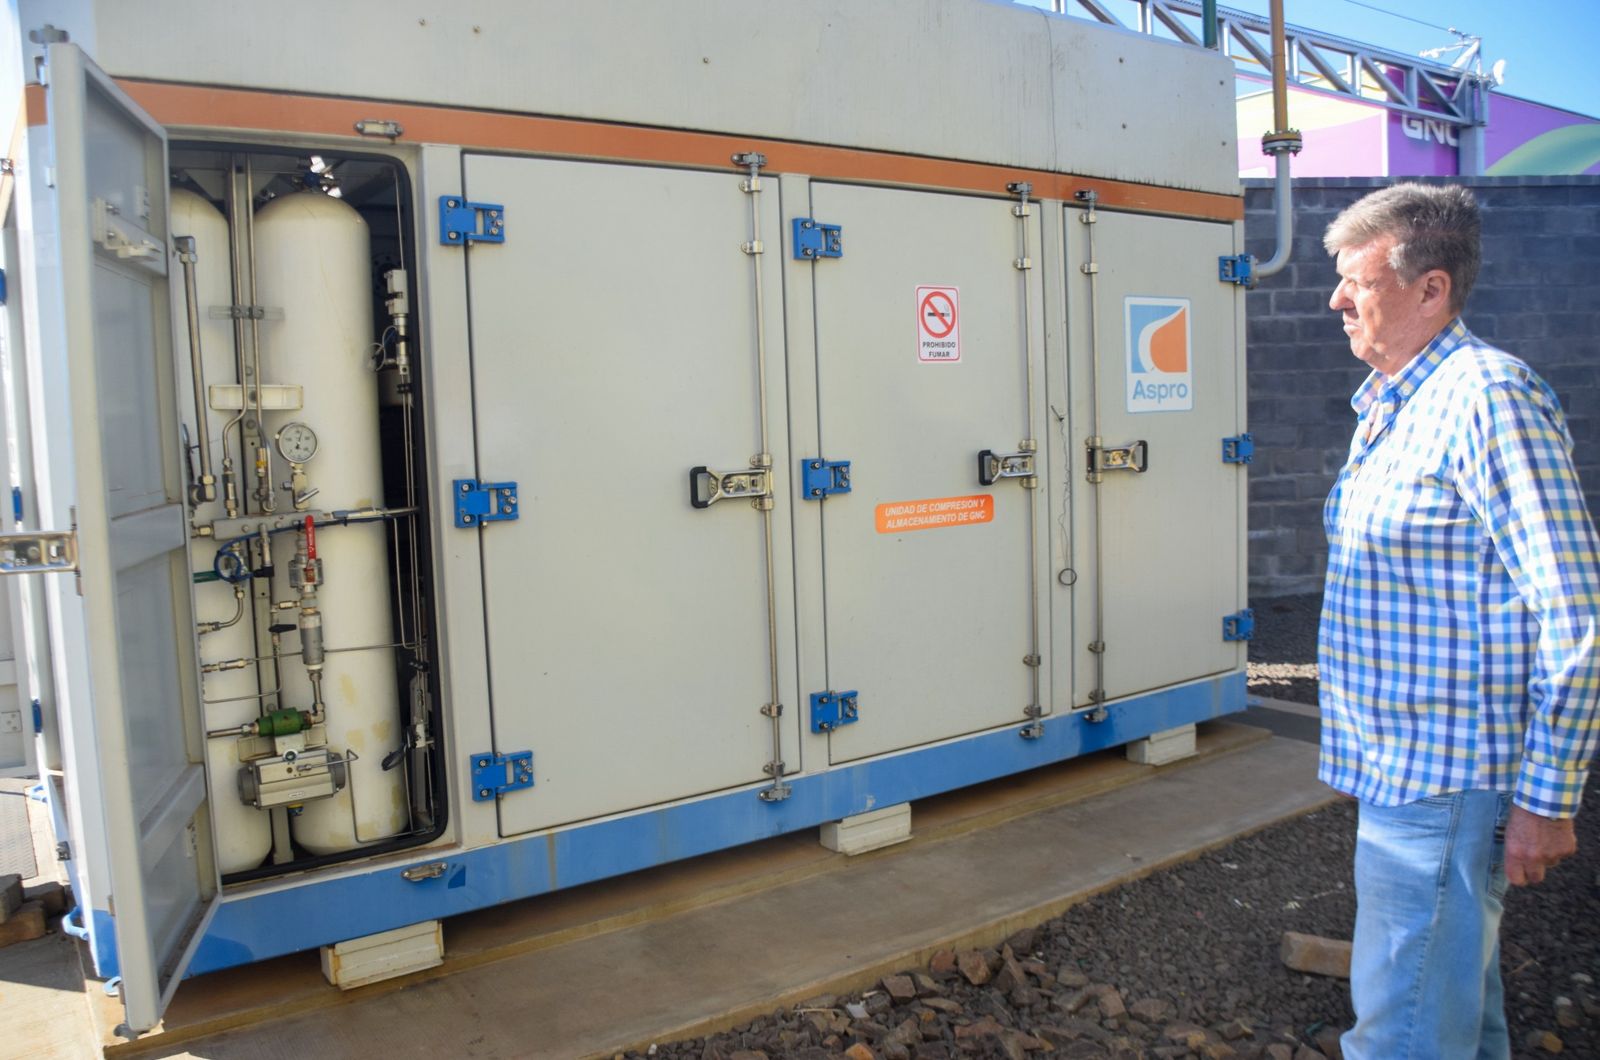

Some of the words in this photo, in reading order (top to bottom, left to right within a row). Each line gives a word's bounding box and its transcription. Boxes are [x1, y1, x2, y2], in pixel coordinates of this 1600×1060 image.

[1132, 380, 1188, 404] Aspro
[885, 505, 915, 517] UNIDAD
[916, 503, 927, 513] DE
[929, 499, 978, 512] COMPRESION
[979, 498, 986, 507] Y
[887, 514, 957, 528] ALMACENAMIENTO
[958, 512, 969, 521] DE
[969, 510, 986, 520] GNC
